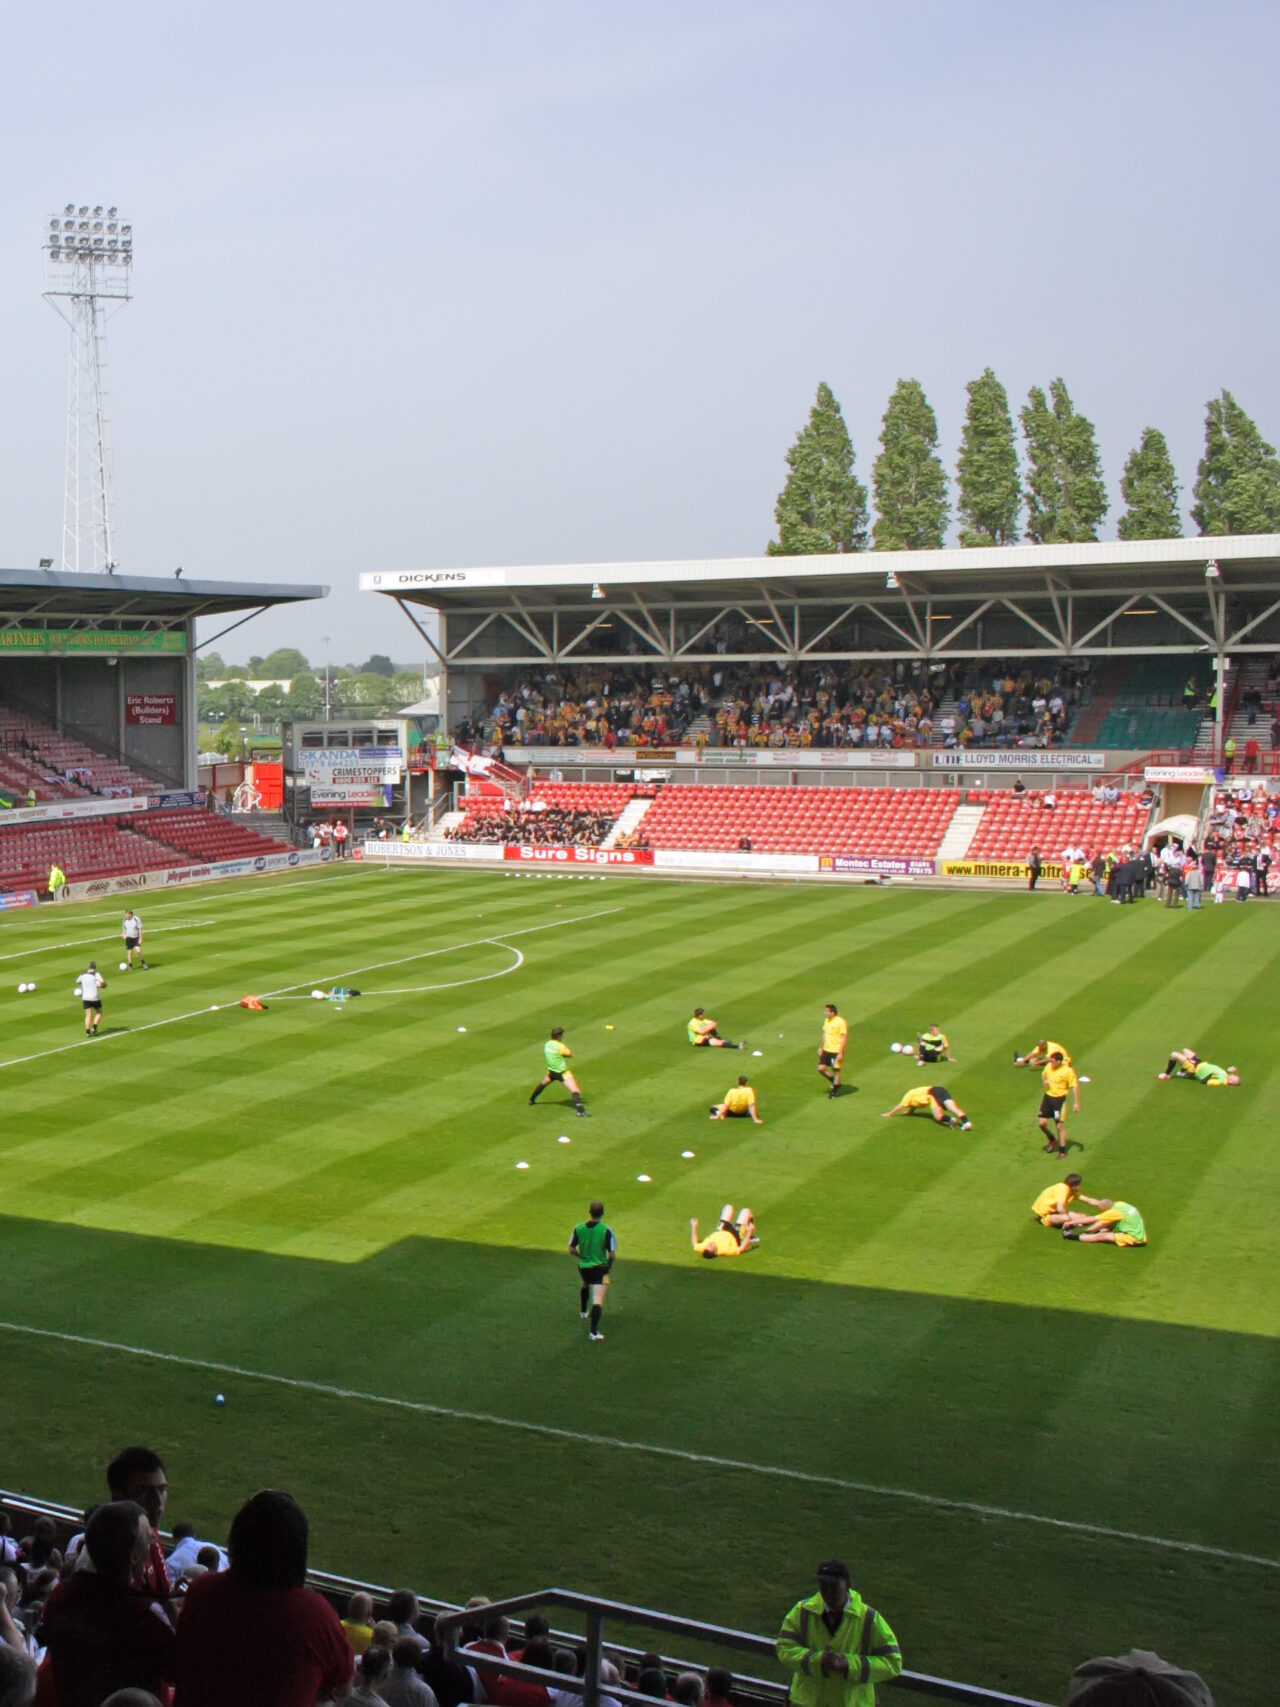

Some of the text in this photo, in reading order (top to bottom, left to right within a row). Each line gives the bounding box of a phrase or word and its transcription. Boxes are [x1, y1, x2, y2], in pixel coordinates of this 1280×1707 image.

[398, 572, 467, 583] DICKENS
[300, 750, 359, 760] SKANDA
[964, 755, 996, 765] LLOYD
[998, 754, 1037, 765] MORRIS
[1040, 754, 1093, 765] ELECTRICAL
[332, 766, 397, 777] CRIMESTOPPERS
[312, 790, 346, 800] Evening
[367, 842, 423, 856] ROBERTSON
[425, 845, 433, 856] &
[437, 845, 467, 857] JONES
[520, 846, 635, 864] Sure Signs
[835, 858, 868, 869] Montec
[870, 859, 906, 870] Estates
